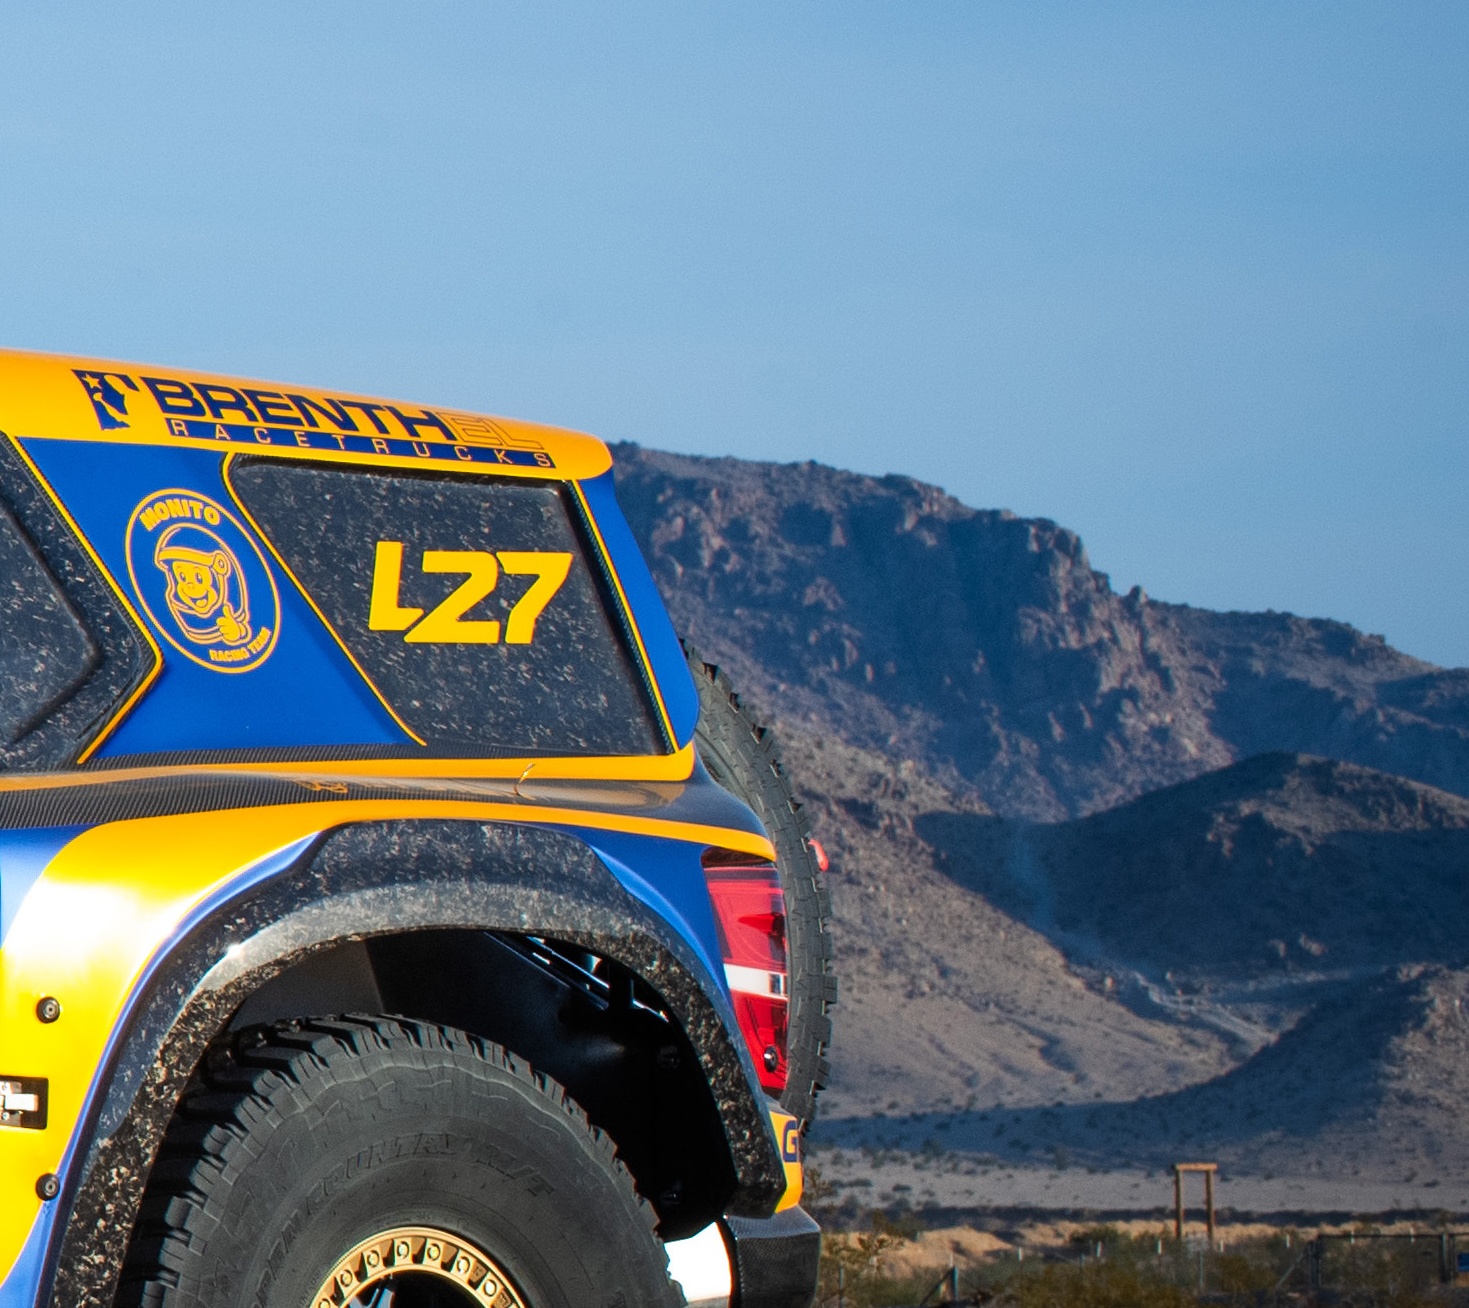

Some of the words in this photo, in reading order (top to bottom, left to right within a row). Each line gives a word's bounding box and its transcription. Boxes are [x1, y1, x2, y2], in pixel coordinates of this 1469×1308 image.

[141, 376, 543, 450] BRENTHEL
[170, 418, 551, 467] RACETRUCKS
[139, 498, 221, 532] MONITO
[368, 541, 573, 644] L27
[209, 647, 251, 662] RACING
[247, 626, 272, 655] TEAM
